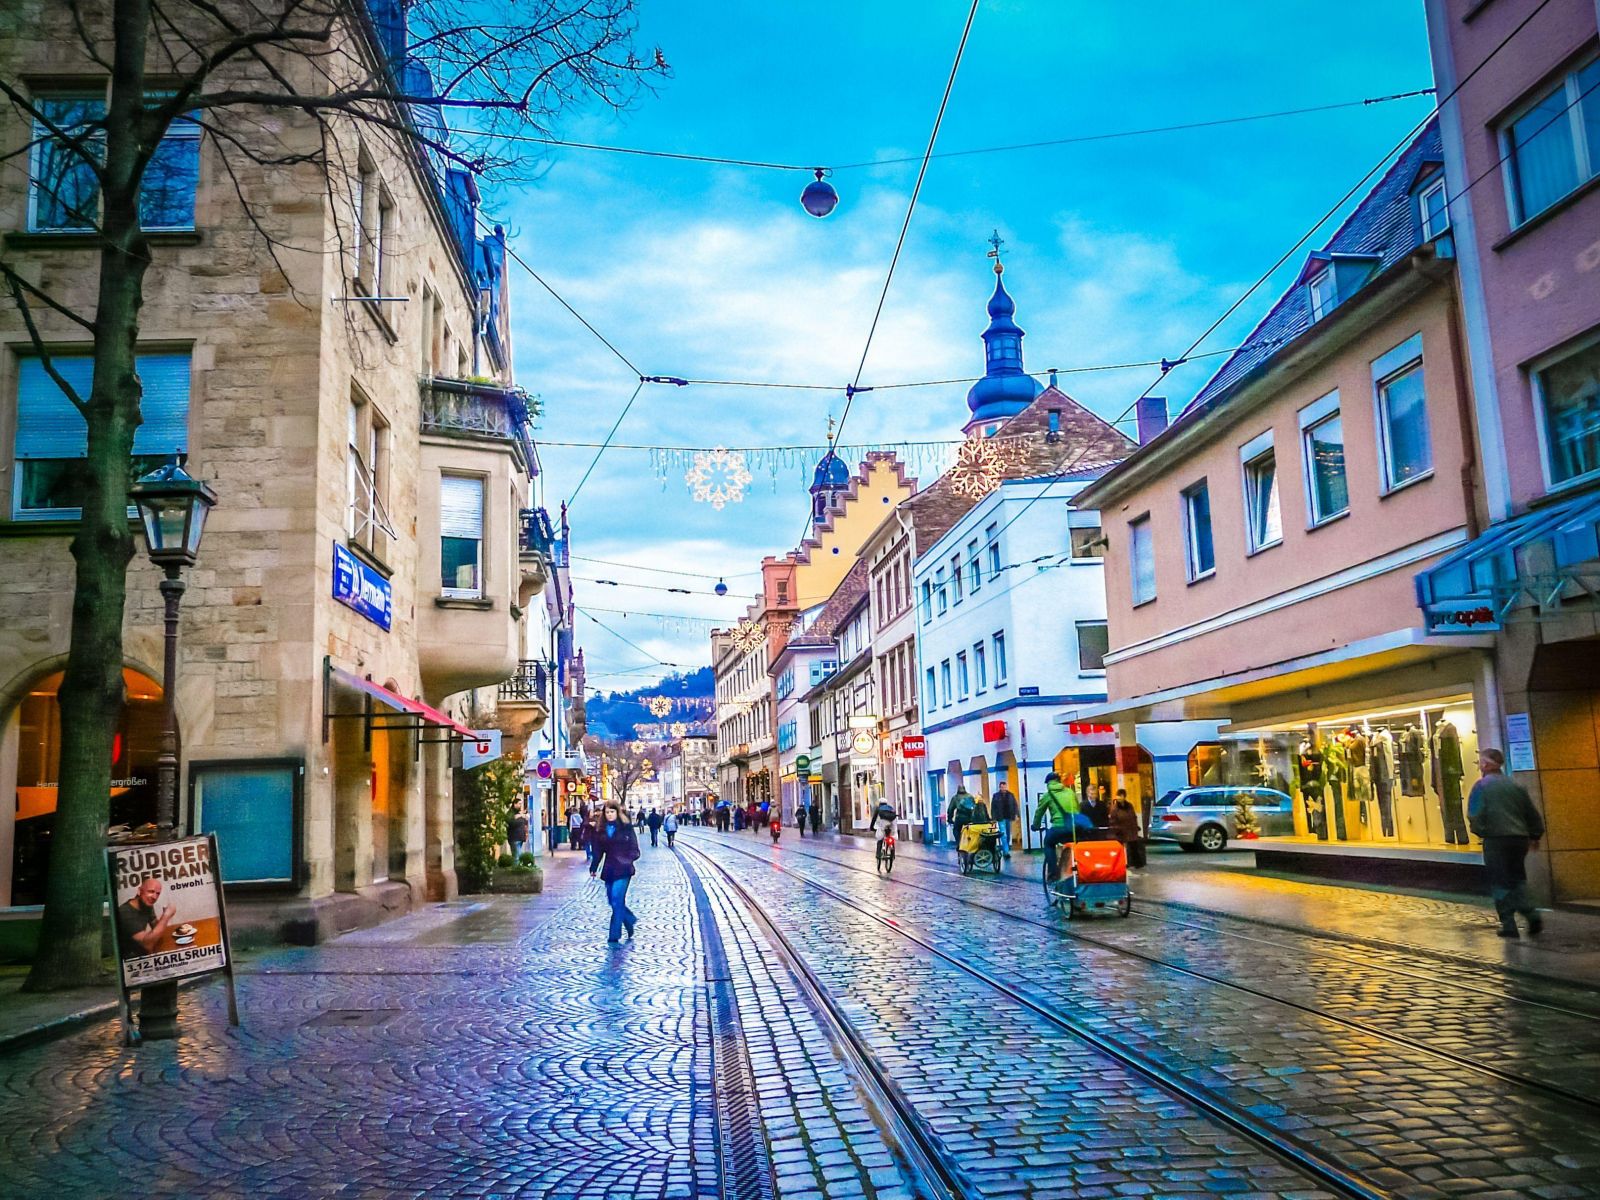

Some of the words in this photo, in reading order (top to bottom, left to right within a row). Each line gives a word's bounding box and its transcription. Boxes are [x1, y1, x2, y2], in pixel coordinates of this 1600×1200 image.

[904, 741, 925, 750] NKD
[110, 776, 147, 788] ergrößen
[117, 844, 208, 874] RÜDIGER
[117, 861, 213, 889] HOFFMANN
[170, 878, 204, 891] obwohl
[153, 944, 222, 967] KARLSRUHE
